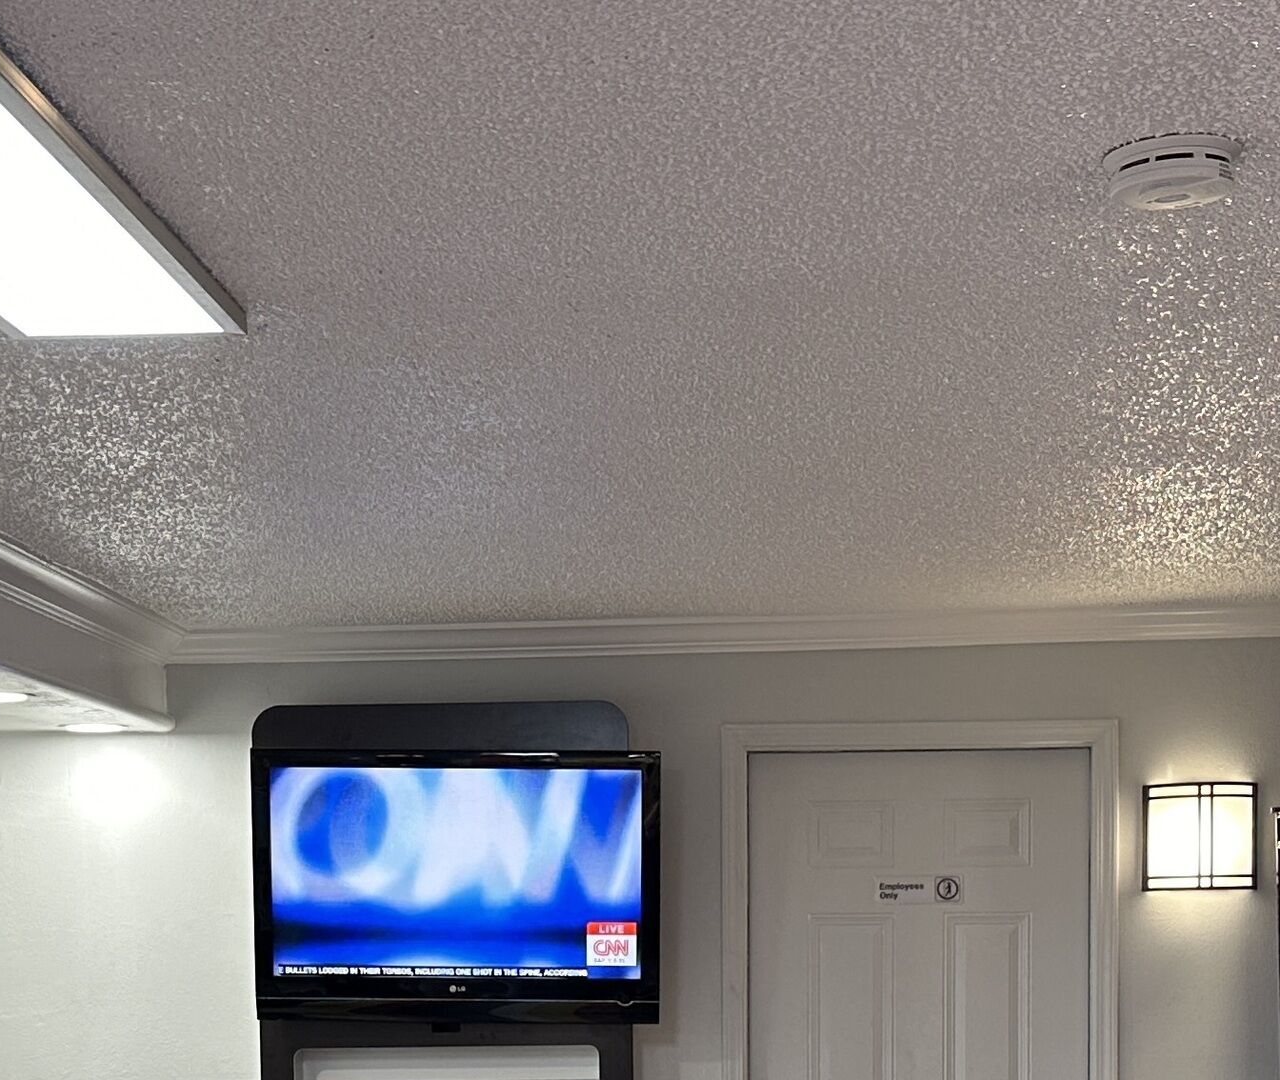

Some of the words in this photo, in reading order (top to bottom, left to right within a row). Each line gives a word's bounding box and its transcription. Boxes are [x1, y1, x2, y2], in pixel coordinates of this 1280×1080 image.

[879, 882, 924, 892] Employees
[879, 891, 898, 900] Only
[599, 924, 625, 934] LIVE
[593, 939, 629, 957] CNN
[285, 967, 318, 975] BULLETS
[349, 967, 358, 975] IN
[455, 968, 472, 976] ONE
[473, 968, 493, 976] SHOT
[494, 968, 503, 976] IN
[504, 968, 518, 976] THE
